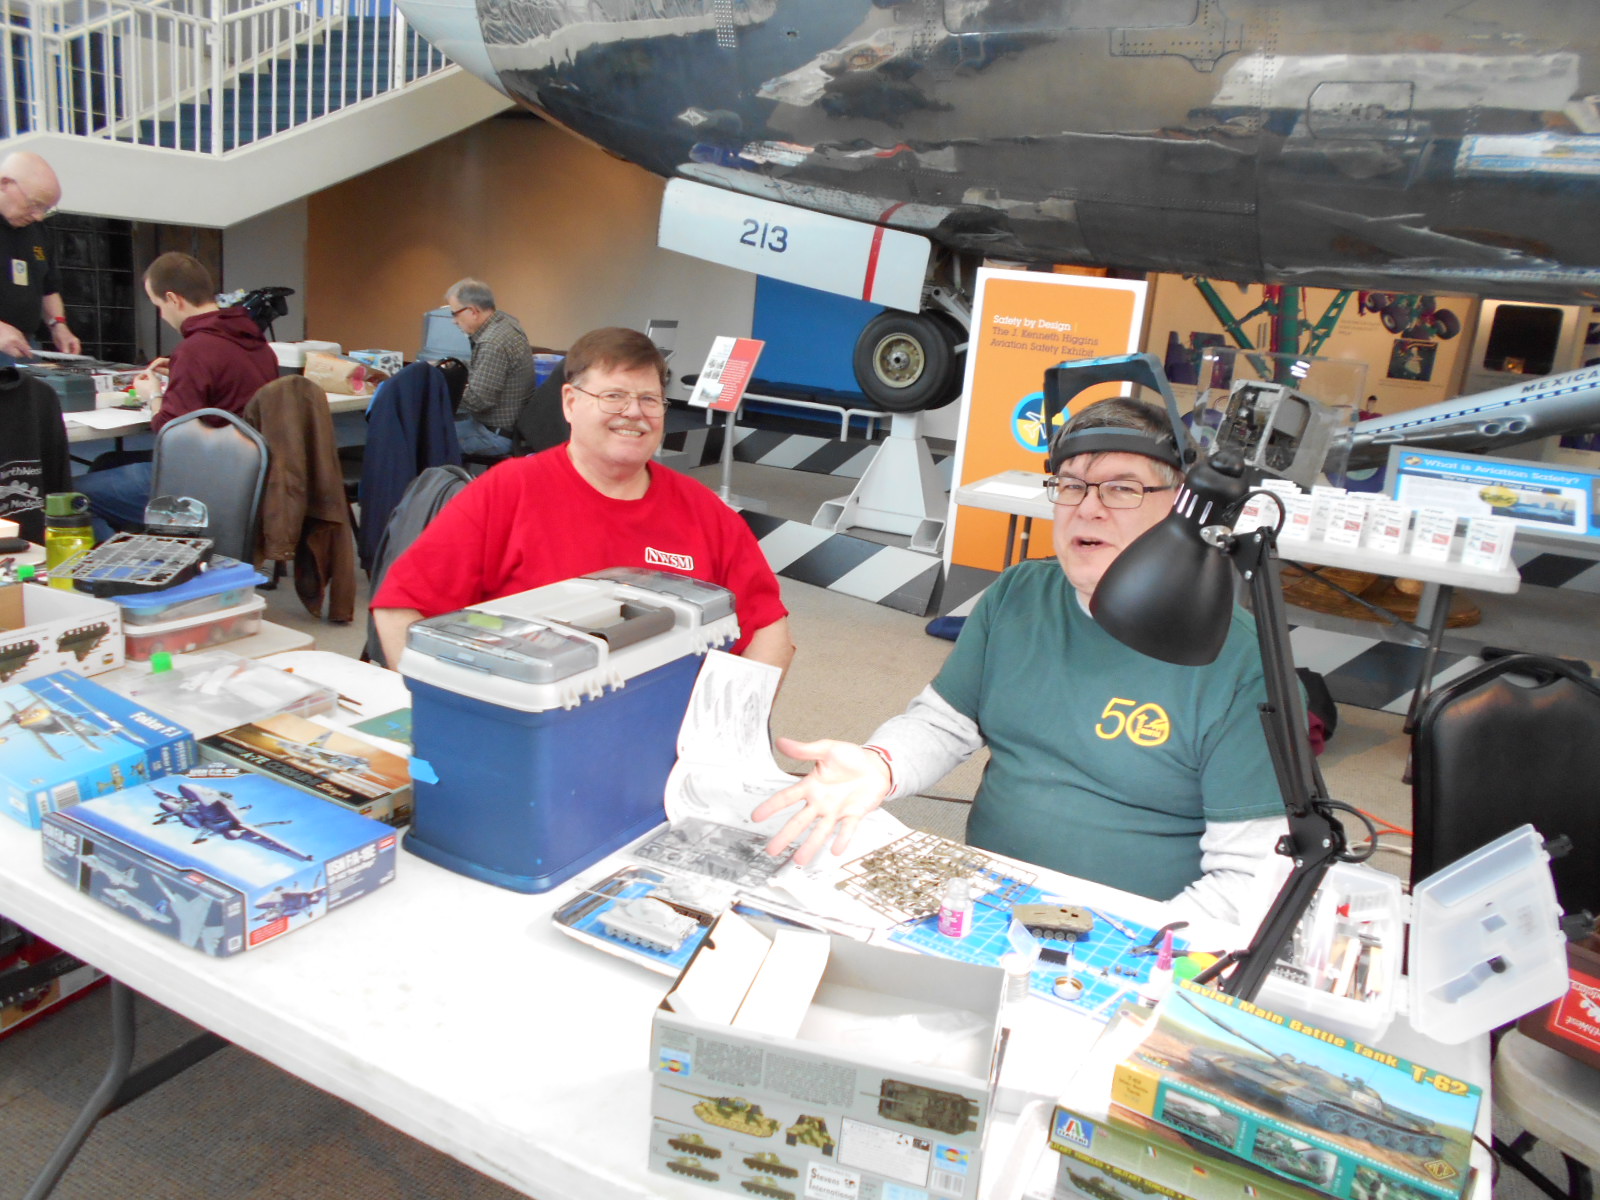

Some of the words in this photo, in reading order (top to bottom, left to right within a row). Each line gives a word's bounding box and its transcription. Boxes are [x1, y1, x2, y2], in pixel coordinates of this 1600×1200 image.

[740, 218, 788, 253] 213
[993, 314, 1022, 328] Safety
[1024, 318, 1036, 329] by
[1038, 319, 1072, 332] Design
[990, 338, 1028, 350] Aviation
[1030, 342, 1060, 355] Safety
[1061, 346, 1095, 357] Exhibit
[992, 327, 1009, 336] The
[1021, 330, 1060, 342] Kenneth
[1062, 333, 1099, 346] Higgins
[1522, 370, 1599, 393] MEXICA
[1424, 458, 1458, 470] What
[1461, 463, 1472, 471] is
[1473, 465, 1529, 478] Aviation
[1532, 472, 1581, 485] Safety?
[647, 548, 692, 570] NWSM
[1179, 979, 1234, 1006] Soviet
[1238, 1000, 1285, 1025] Main
[1289, 1019, 1347, 1048] Battle
[1353, 1042, 1399, 1068] Tank
[1411, 1063, 1470, 1098] T-62
[811, 1168, 840, 1186] Stevens
[808, 1178, 856, 1200] International
